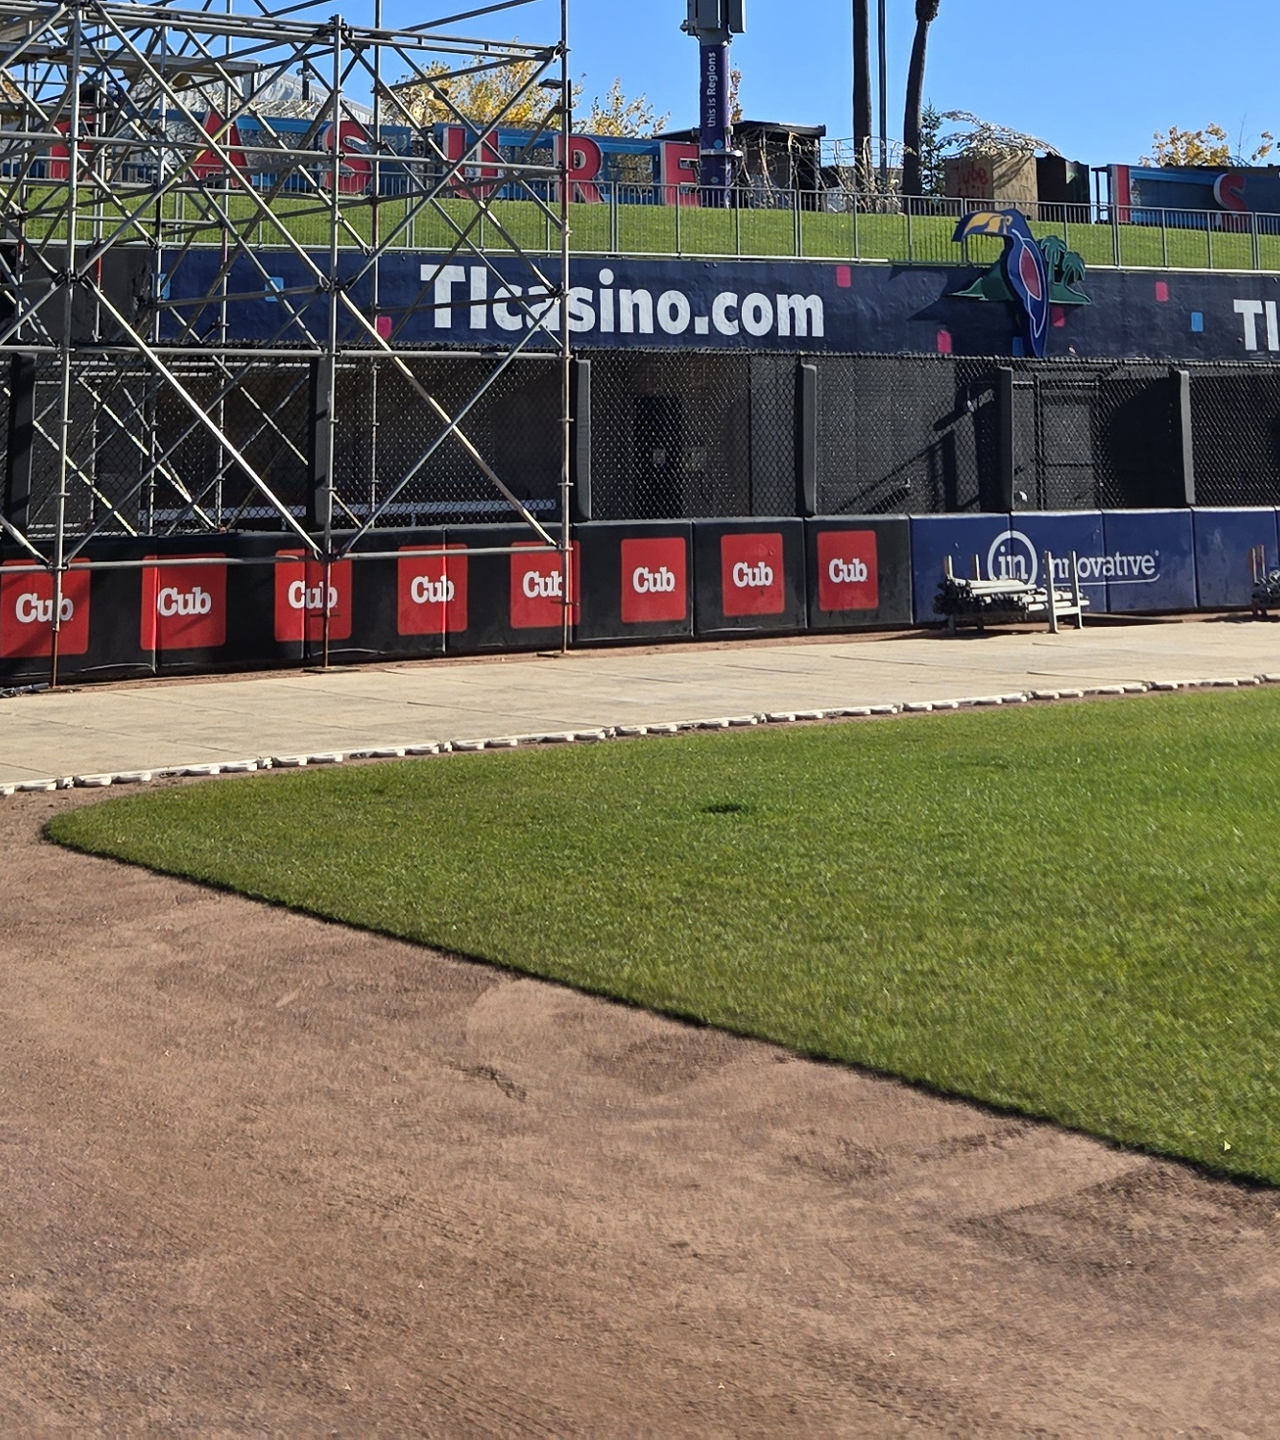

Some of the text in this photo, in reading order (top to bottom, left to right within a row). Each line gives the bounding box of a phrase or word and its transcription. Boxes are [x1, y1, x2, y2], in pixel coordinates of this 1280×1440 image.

[706, 51, 719, 96] Regions
[707, 108, 716, 127] this
[522, 570, 563, 598] Cub
[631, 566, 676, 593] Cub
[732, 561, 774, 588] Cub
[828, 558, 868, 583] Cub
[157, 586, 212, 617] Cub
[287, 580, 338, 609] Cub
[410, 575, 455, 604] Cub
[15, 592, 74, 623] Cub
